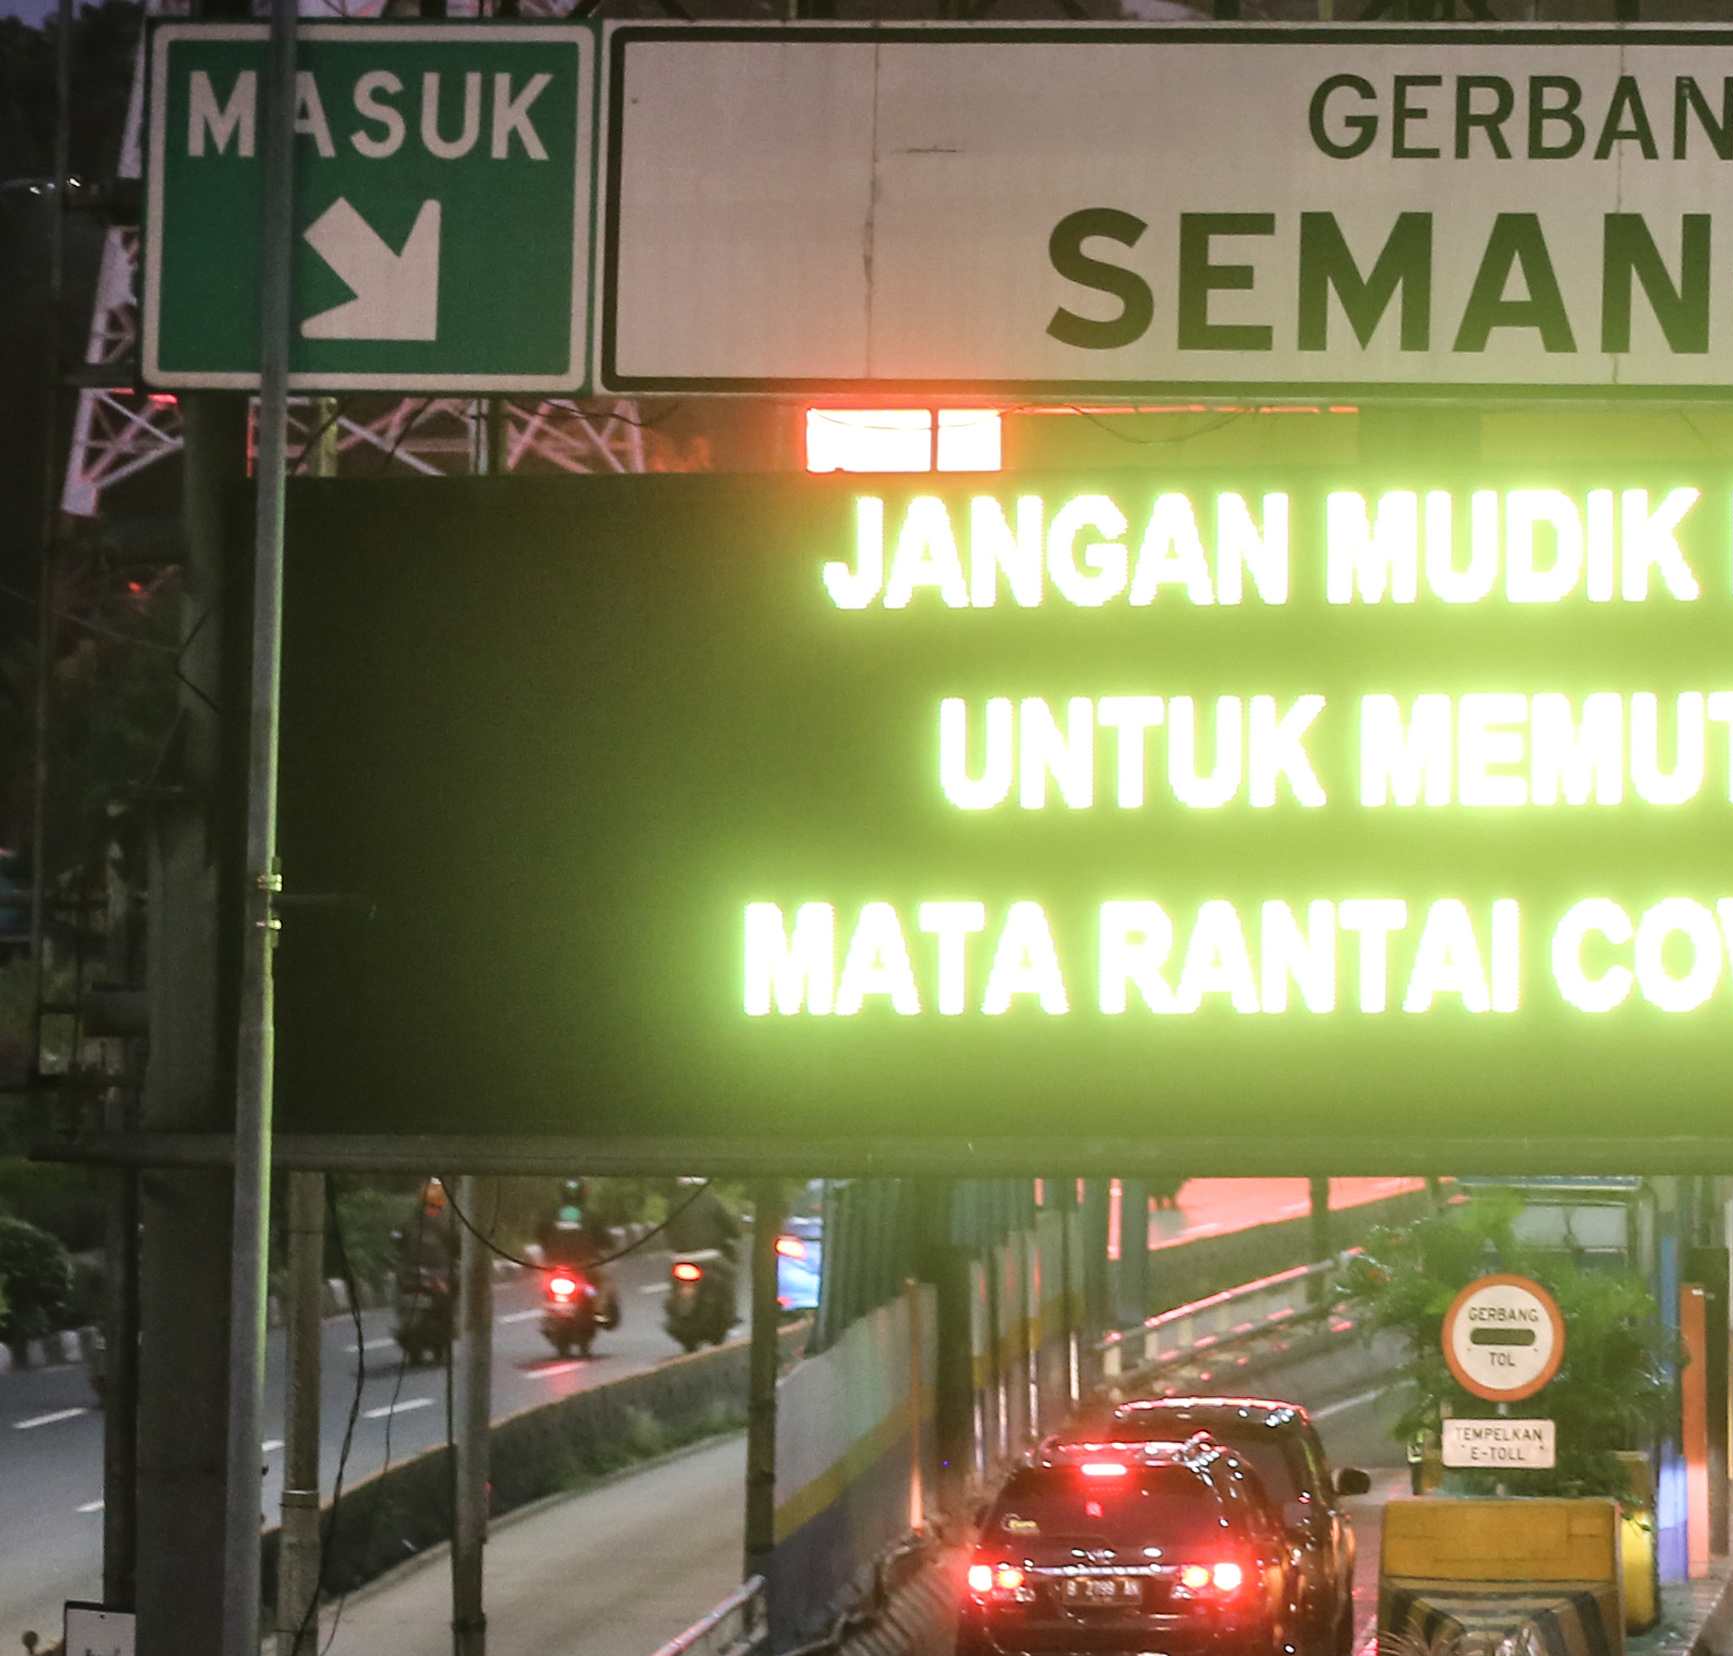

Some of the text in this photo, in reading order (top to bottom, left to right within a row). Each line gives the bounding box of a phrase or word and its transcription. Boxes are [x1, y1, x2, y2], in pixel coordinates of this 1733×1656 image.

[188, 70, 554, 160] MASUK
[822, 493, 1288, 609] JANGAN
[1326, 488, 1699, 604] MUDIK
[939, 695, 1326, 809] UNTUK
[743, 902, 1069, 1015] MATA
[1098, 899, 1519, 1014] RANTAI
[1468, 1307, 1539, 1322] GERBANG
[1488, 1352, 1516, 1366] TOL
[1455, 1427, 1542, 1442] TEMPELKAN
[1470, 1447, 1525, 1461] E-TOLL
